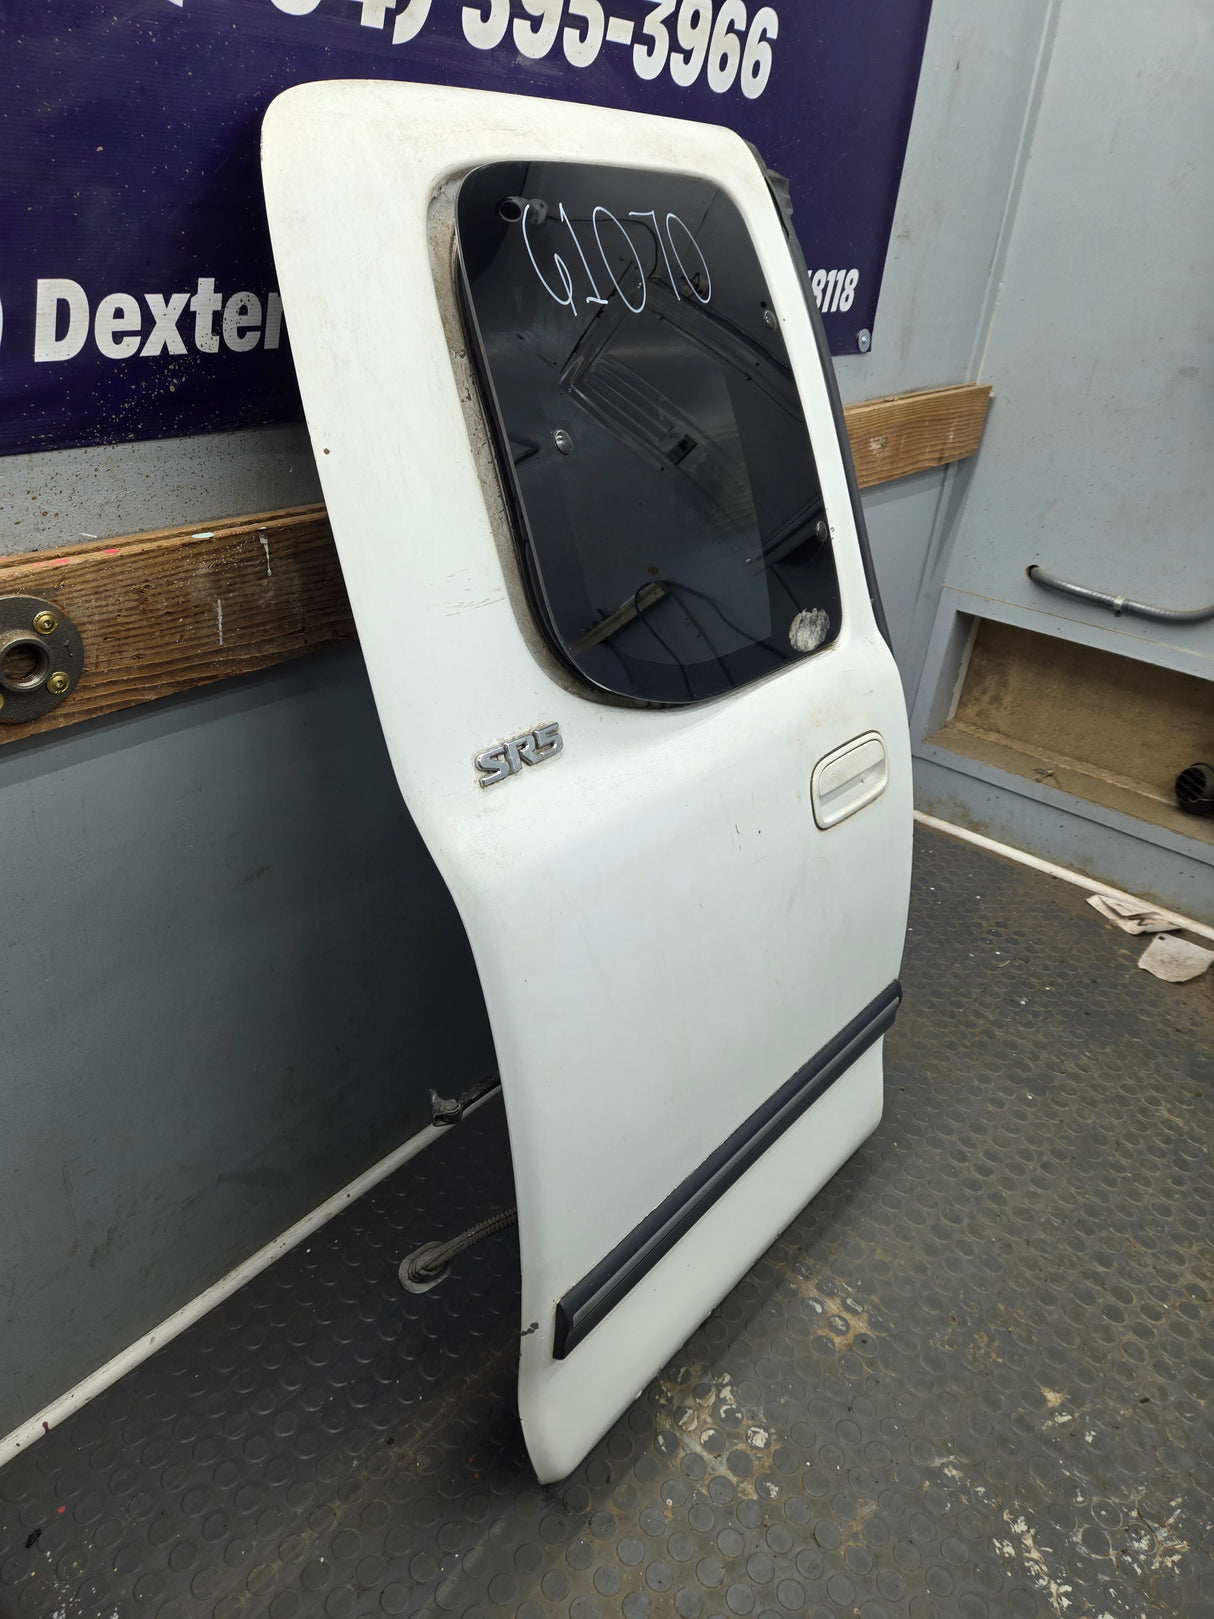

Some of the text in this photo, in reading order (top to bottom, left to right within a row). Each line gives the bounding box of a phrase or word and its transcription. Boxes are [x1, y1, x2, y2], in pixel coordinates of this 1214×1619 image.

[522, 203, 711, 316] 61070
[808, 268, 859, 312] 8118
[474, 722, 563, 789] SR5
